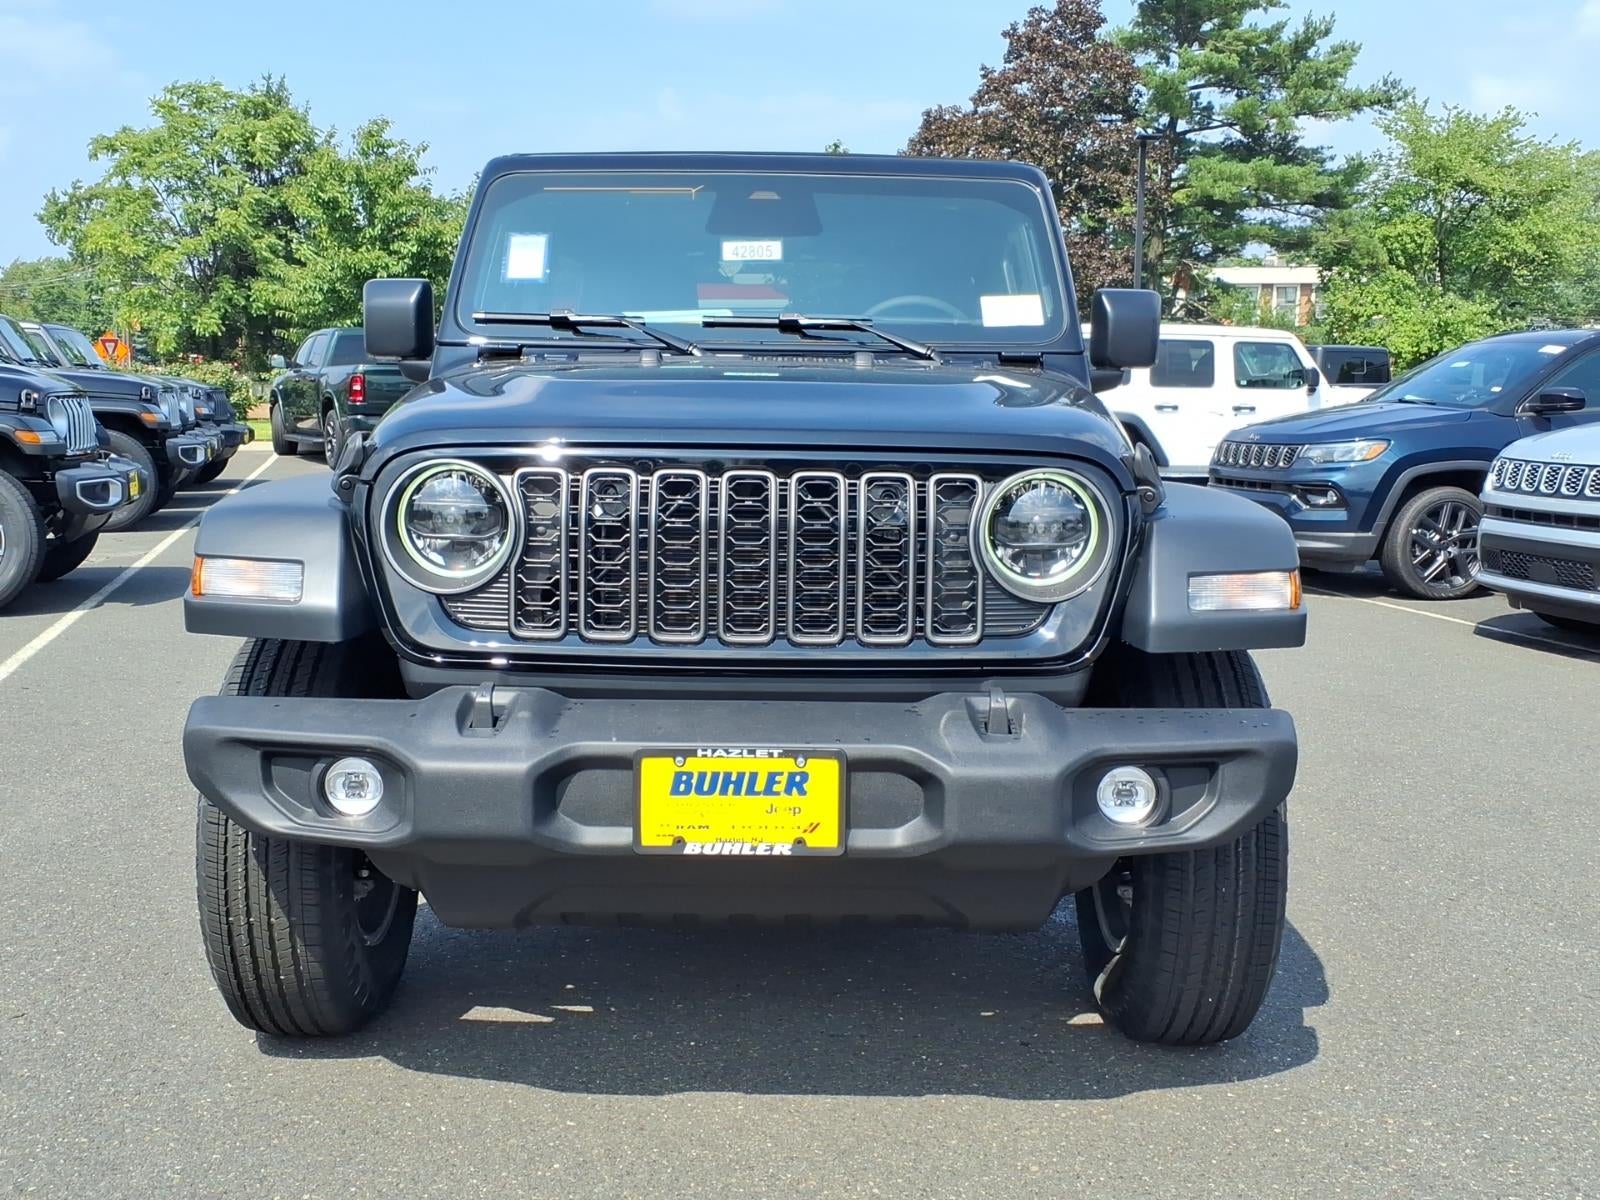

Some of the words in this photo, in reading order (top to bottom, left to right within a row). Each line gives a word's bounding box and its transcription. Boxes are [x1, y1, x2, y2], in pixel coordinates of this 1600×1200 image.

[731, 244, 774, 258] 42805
[696, 747, 784, 758] HAZLET
[669, 770, 810, 796] BUHLER
[765, 803, 802, 816] Jp
[683, 841, 793, 855] BUHLER
